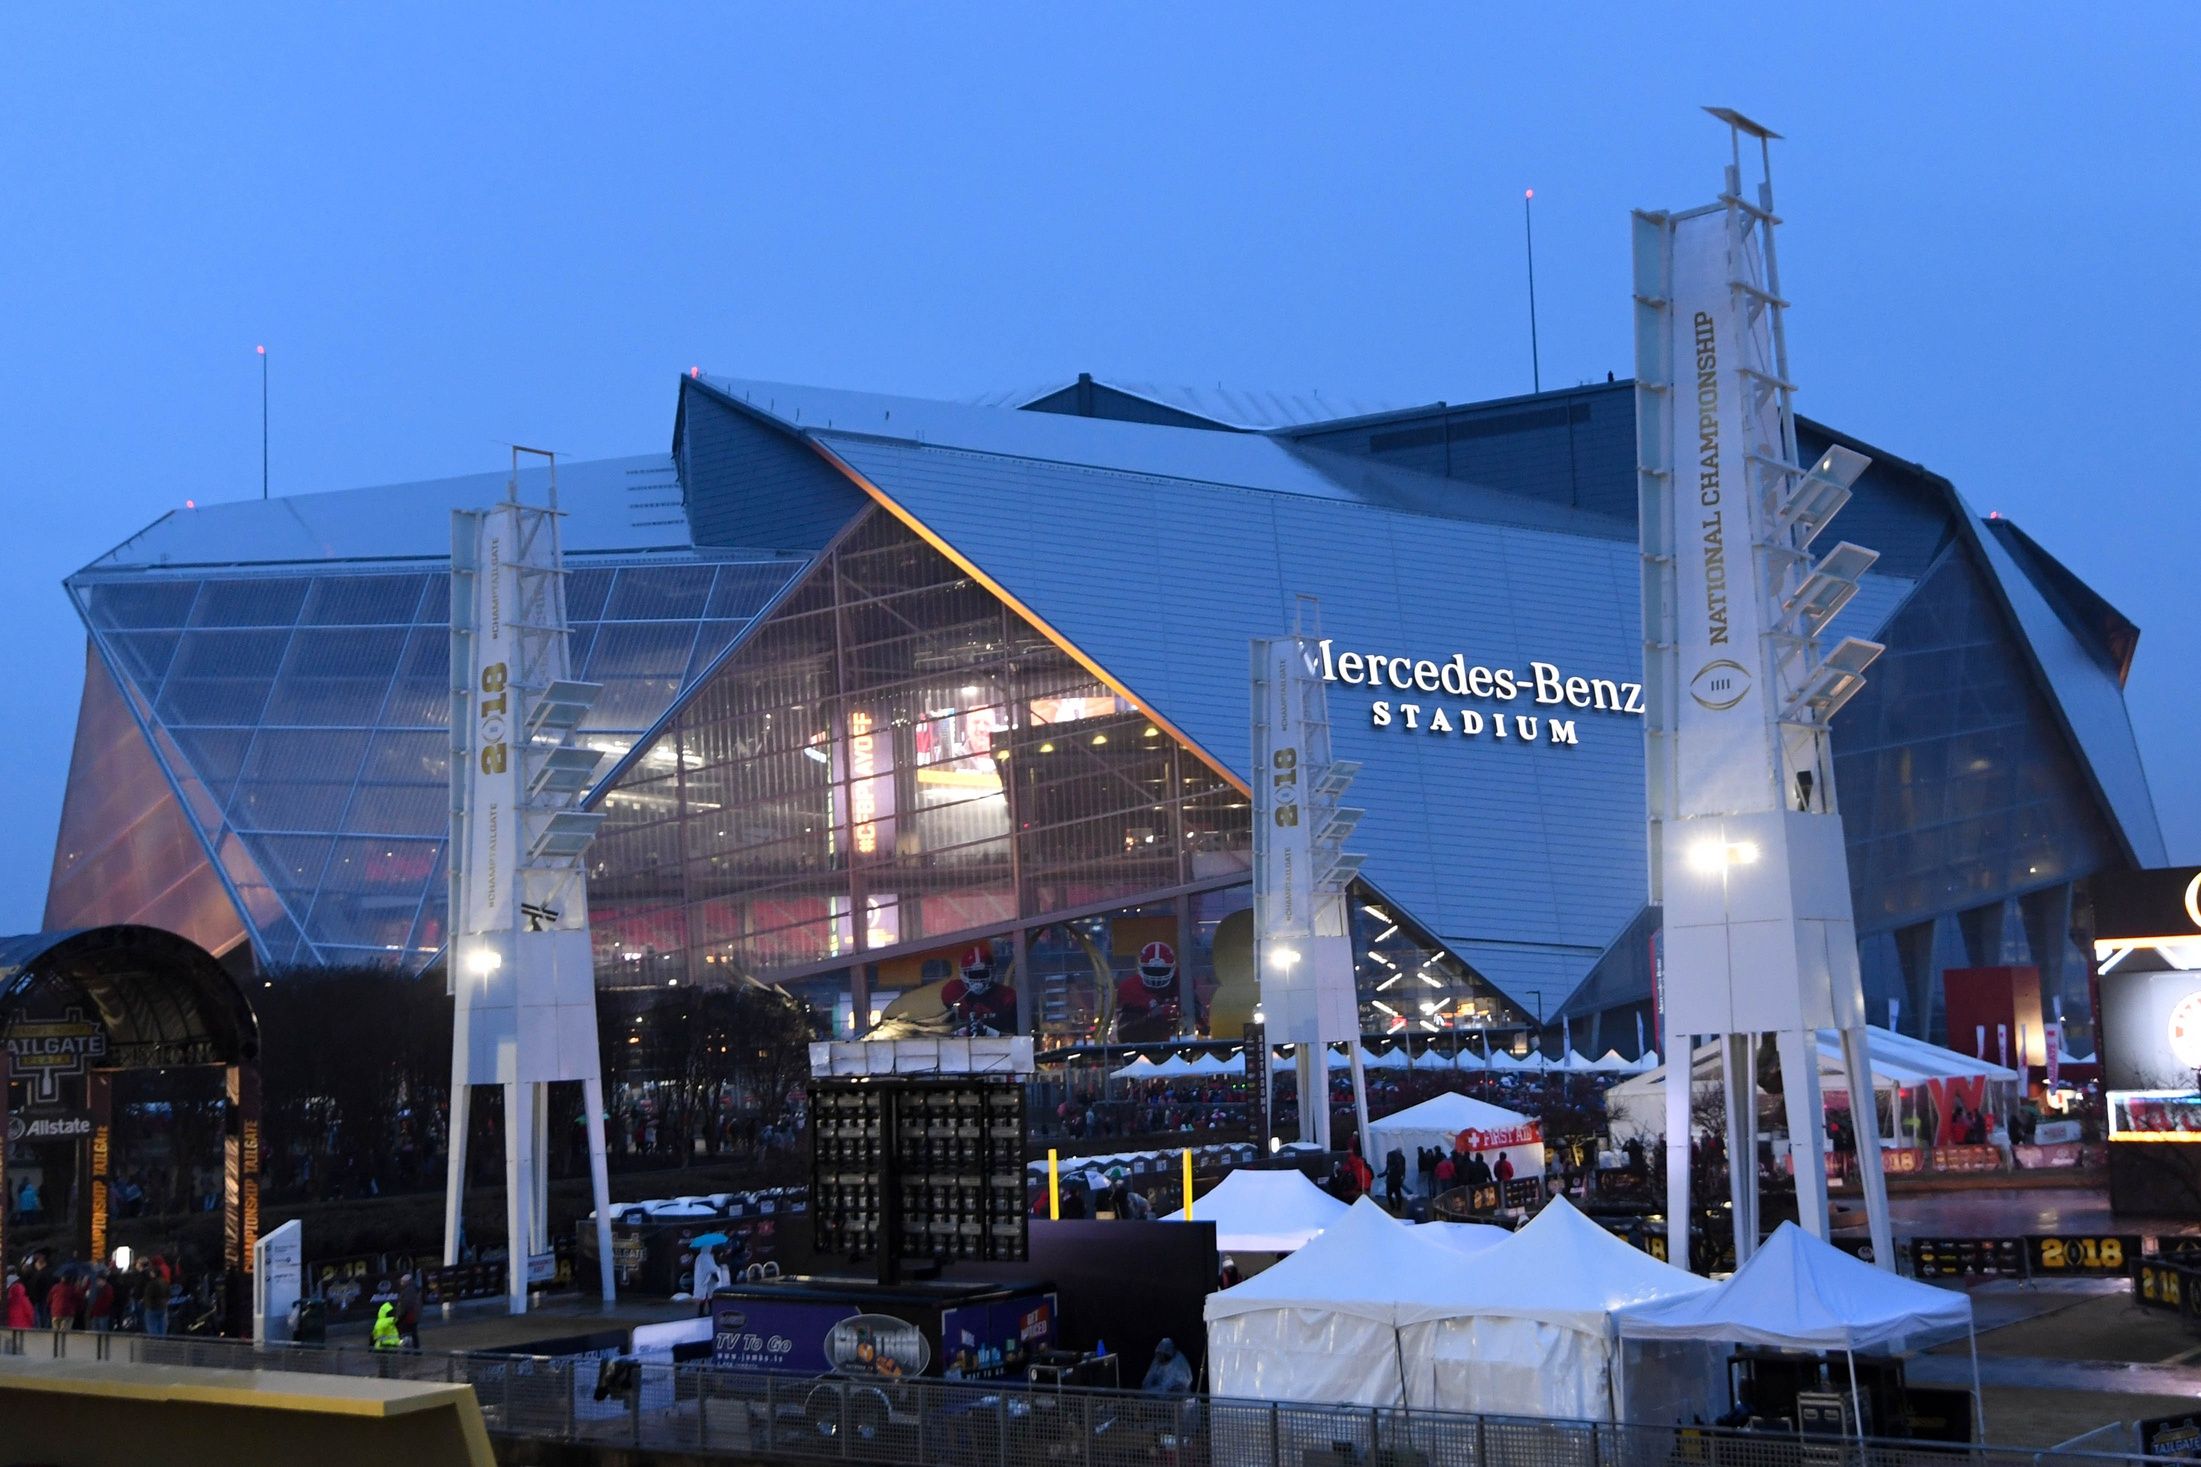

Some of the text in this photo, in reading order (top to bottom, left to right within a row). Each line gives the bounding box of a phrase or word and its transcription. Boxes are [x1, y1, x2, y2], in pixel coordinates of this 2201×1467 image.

[1694, 311, 1728, 646] NATIONAL CHAMPIONSHIP
[1298, 638, 1645, 714] Mercedes-Benz
[481, 661, 507, 776] 2018
[1371, 700, 1579, 745] STADIUM
[852, 712, 876, 853] #CFBPLAYOFF
[26, 1115, 91, 1137] Allstate
[243, 1119, 260, 1173] TAILGATE
[1483, 1127, 1514, 1147] FIRST
[2040, 1236, 2124, 1269] 2018
[716, 1332, 793, 1353] TV To Go
